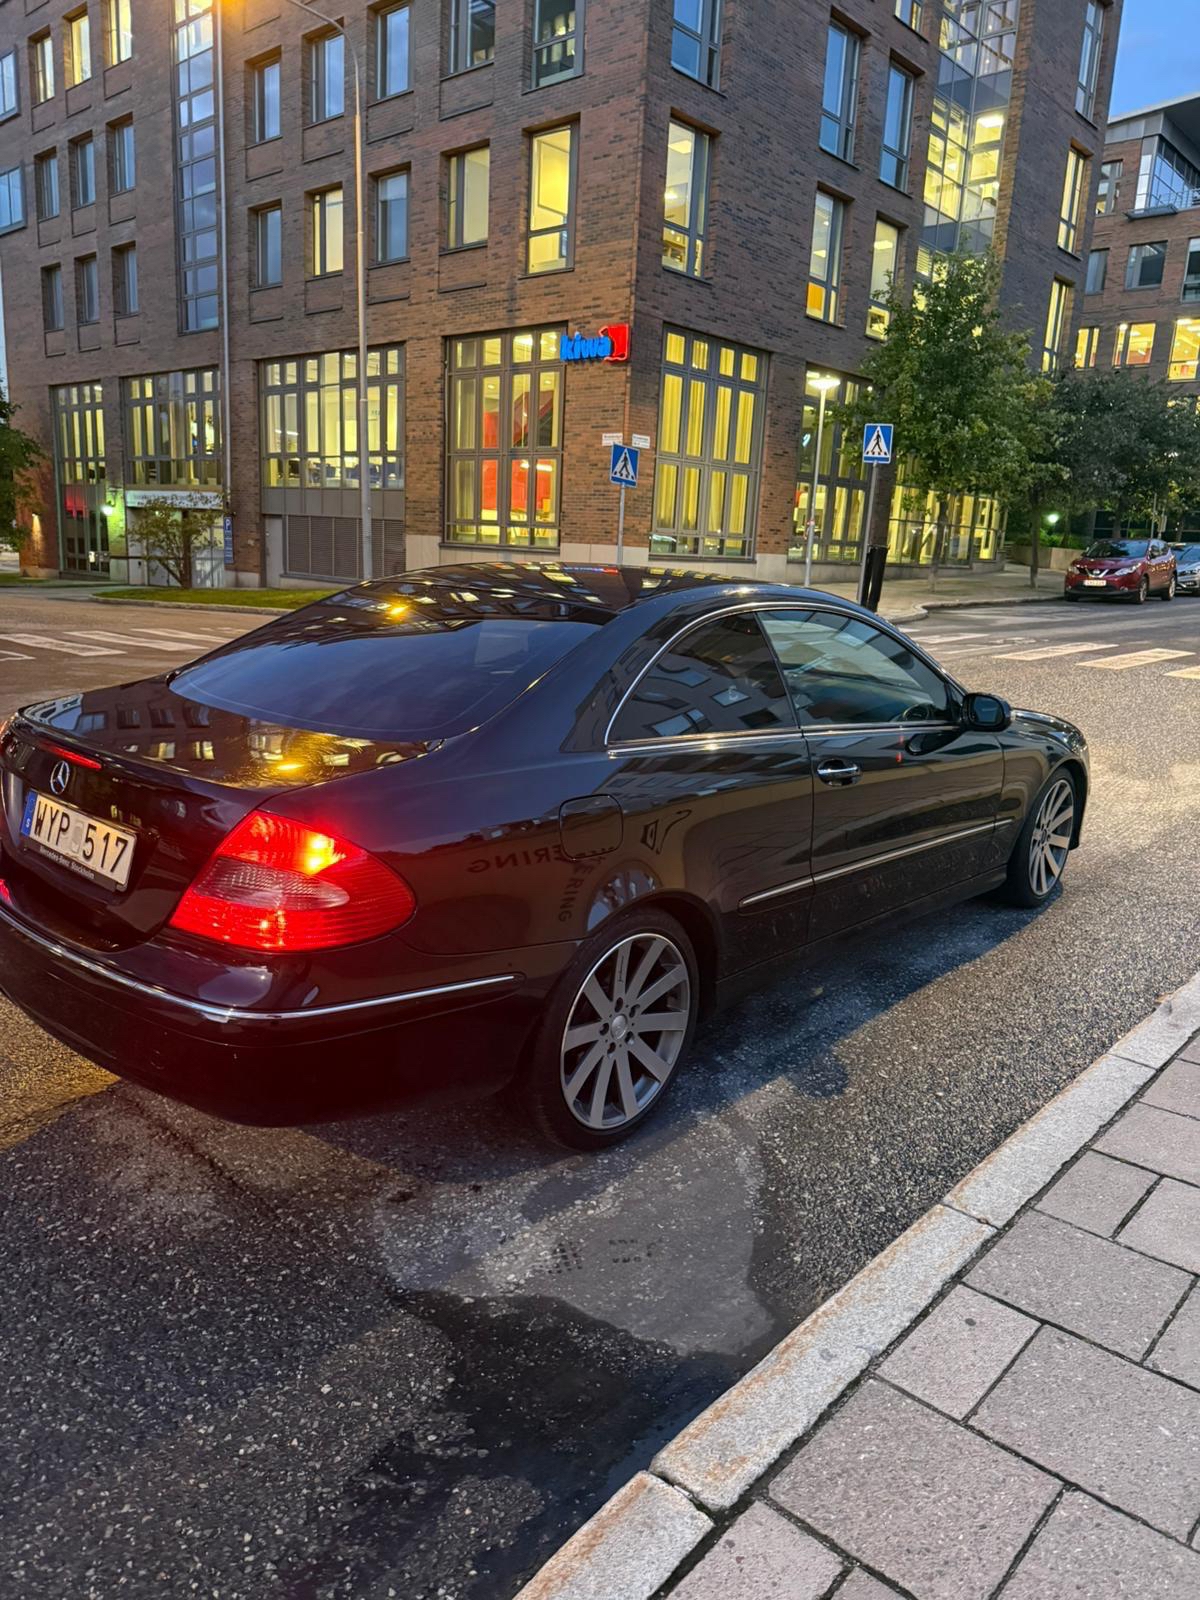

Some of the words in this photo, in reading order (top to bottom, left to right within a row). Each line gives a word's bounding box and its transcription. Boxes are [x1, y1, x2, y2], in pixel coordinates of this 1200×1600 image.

[560, 332, 611, 361] kiwa
[34, 800, 71, 846] WYP
[83, 823, 129, 874] 517
[71, 860, 95, 880] Stockholm
